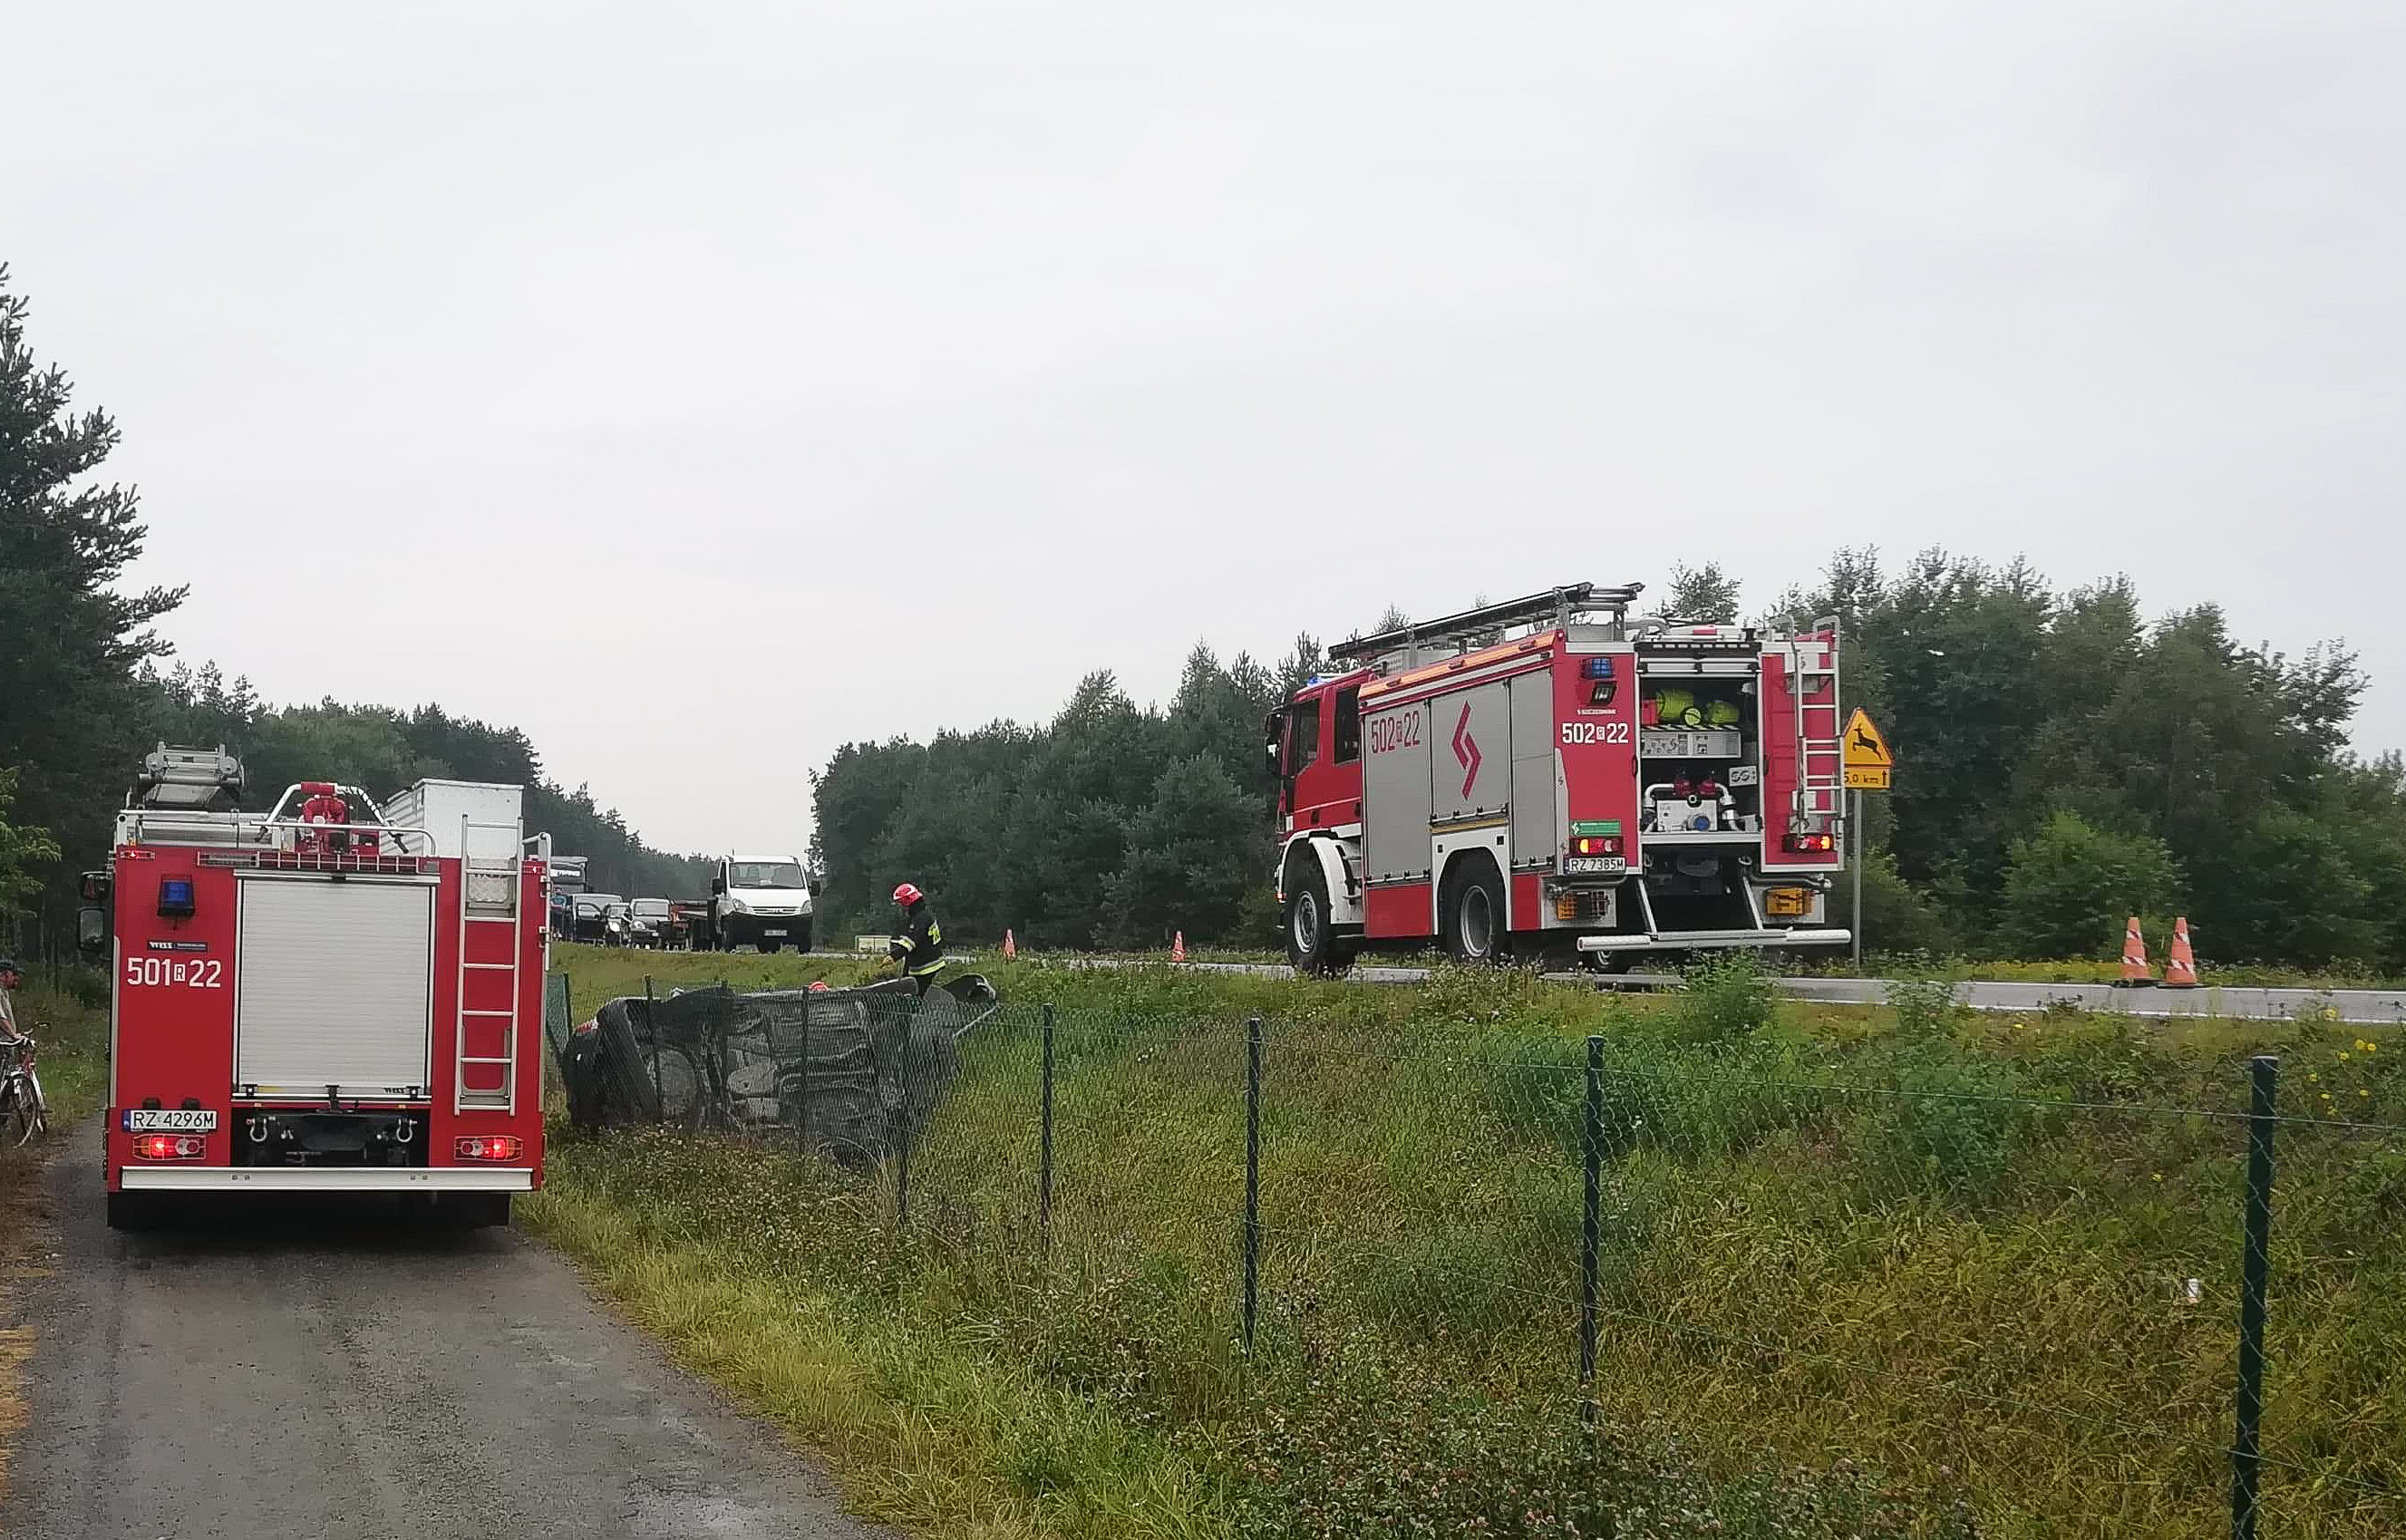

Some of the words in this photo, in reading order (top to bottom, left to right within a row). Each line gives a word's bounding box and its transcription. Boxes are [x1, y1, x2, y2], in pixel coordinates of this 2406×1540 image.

[1571, 858, 1587, 870] RZ
[133, 1112, 157, 1127] RZ
[162, 1112, 214, 1127] 4296M
